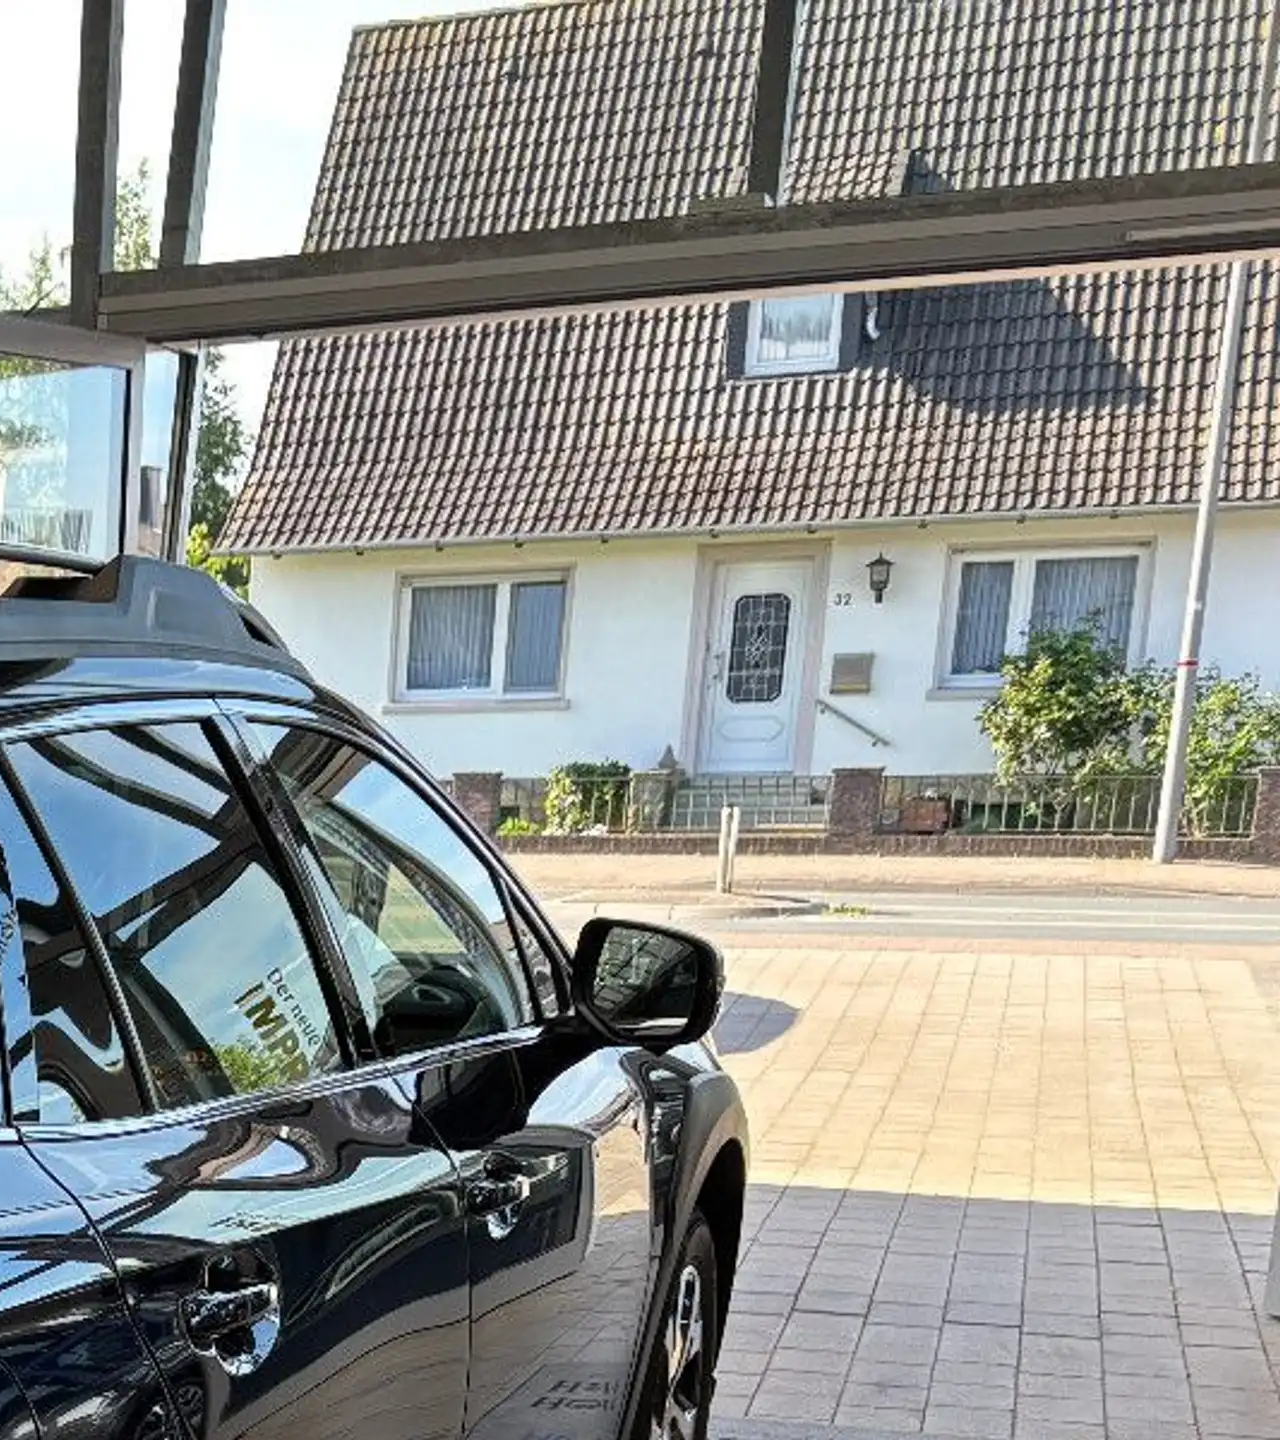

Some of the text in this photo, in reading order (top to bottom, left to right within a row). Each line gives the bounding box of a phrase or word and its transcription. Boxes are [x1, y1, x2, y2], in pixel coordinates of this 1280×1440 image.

[833, 592, 852, 606] 32
[266, 966, 323, 1048] Der neue
